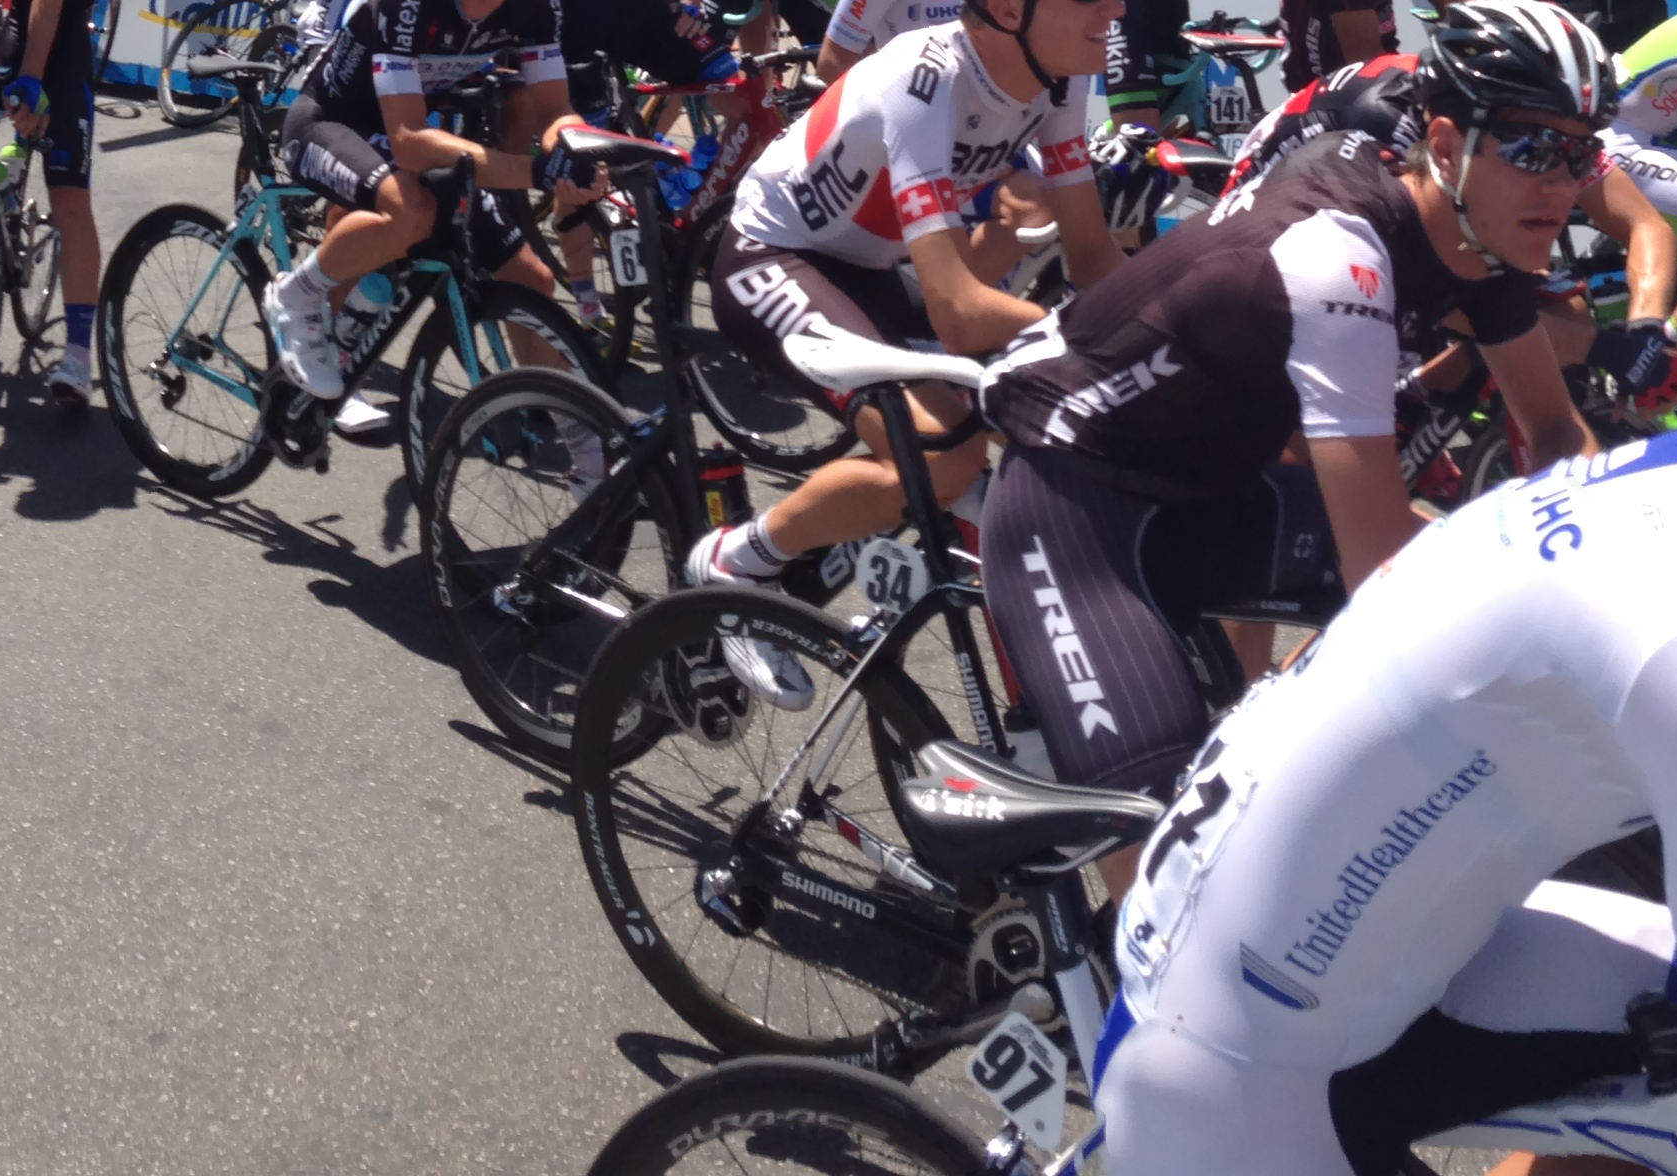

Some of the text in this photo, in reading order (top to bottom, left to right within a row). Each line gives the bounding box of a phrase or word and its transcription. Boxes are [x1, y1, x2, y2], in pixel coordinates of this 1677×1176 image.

[1212, 95, 1245, 121] 141
[792, 141, 869, 232] BMC
[1045, 344, 1183, 445] TREK
[1624, 336, 1665, 385] BMC
[867, 554, 915, 614] 34
[1022, 534, 1120, 741] TREK
[958, 652, 998, 754] SHIMANO
[582, 791, 625, 914] BONTRAGER
[781, 871, 876, 921] SHIMANO
[1284, 750, 1489, 980] UnitedHealthcare
[971, 1032, 1057, 1116] 97
